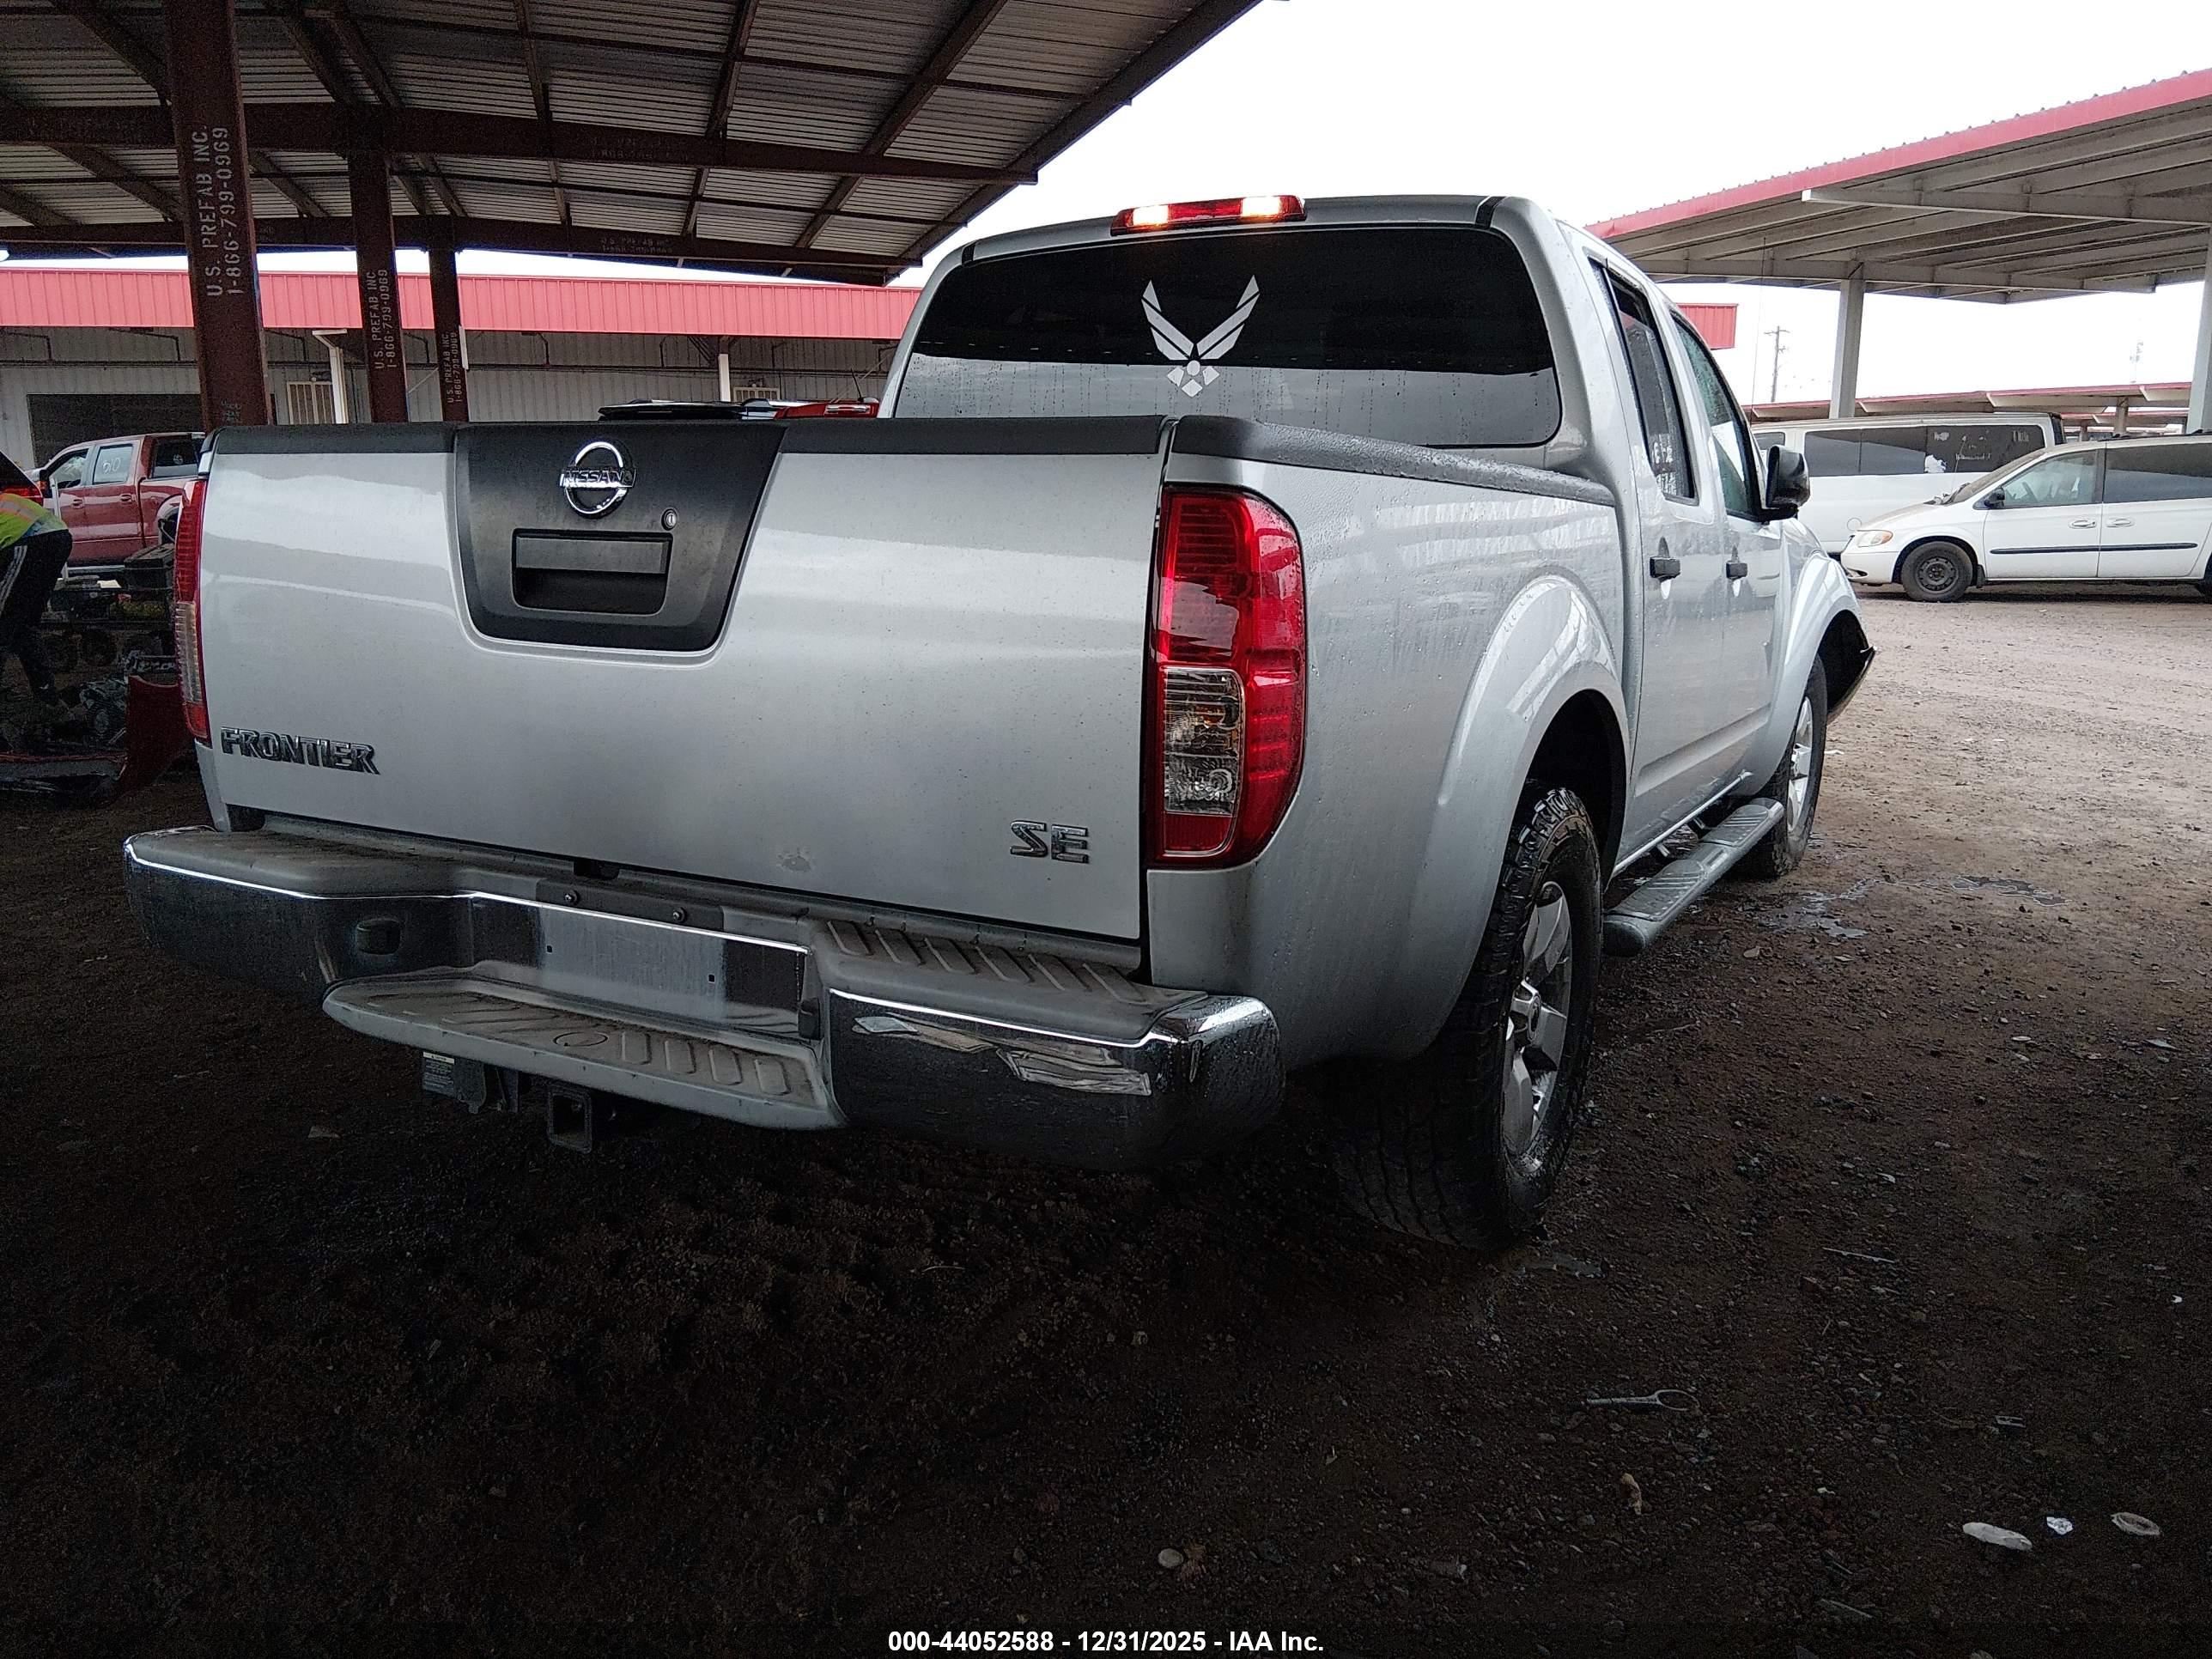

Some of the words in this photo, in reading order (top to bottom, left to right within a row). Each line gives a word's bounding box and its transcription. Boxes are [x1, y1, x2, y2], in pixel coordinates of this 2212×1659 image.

[191, 125, 210, 161] INC.
[196, 173, 219, 248] PREFAB
[212, 127, 245, 295] 1-866-799-0969
[205, 259, 223, 296] U.S.
[368, 296, 382, 341] PREFAB
[378, 269, 397, 368] 1-866-799-0969
[374, 347, 385, 369] U.S.
[562, 468, 628, 485] NISSAN
[221, 726, 381, 775] FRONTIER
[1010, 819, 1090, 864] SE
